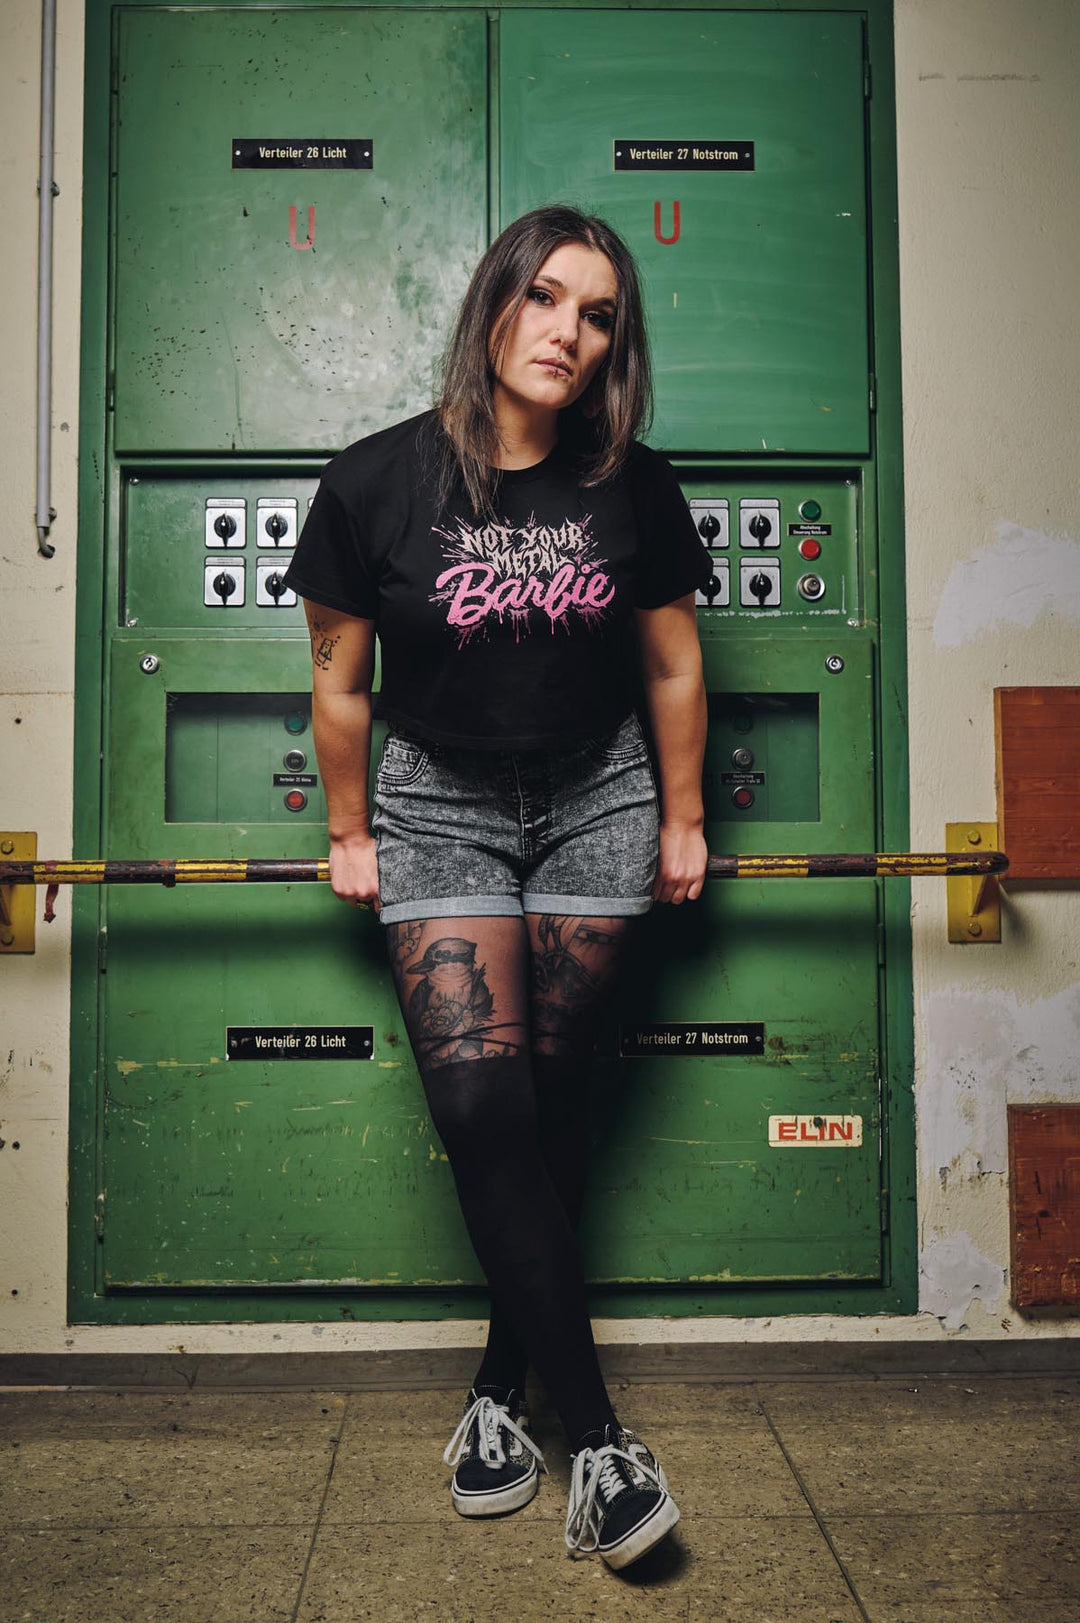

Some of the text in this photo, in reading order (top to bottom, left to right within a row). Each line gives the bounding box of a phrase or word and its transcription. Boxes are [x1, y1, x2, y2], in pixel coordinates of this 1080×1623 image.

[259, 147, 347, 158] Verteiler 26 Licht
[629, 148, 739, 160] Verteiler 27 Notstrom
[289, 205, 316, 250] U
[655, 201, 680, 245] U
[457, 517, 589, 558] NOT YOUR
[484, 546, 574, 580] METAL
[435, 562, 615, 626] Barbie
[255, 1035, 346, 1048] Verteiler 26 Licht
[637, 1032, 748, 1044] Verteiler 27 Notstrom
[778, 1122, 853, 1140] ELIN
